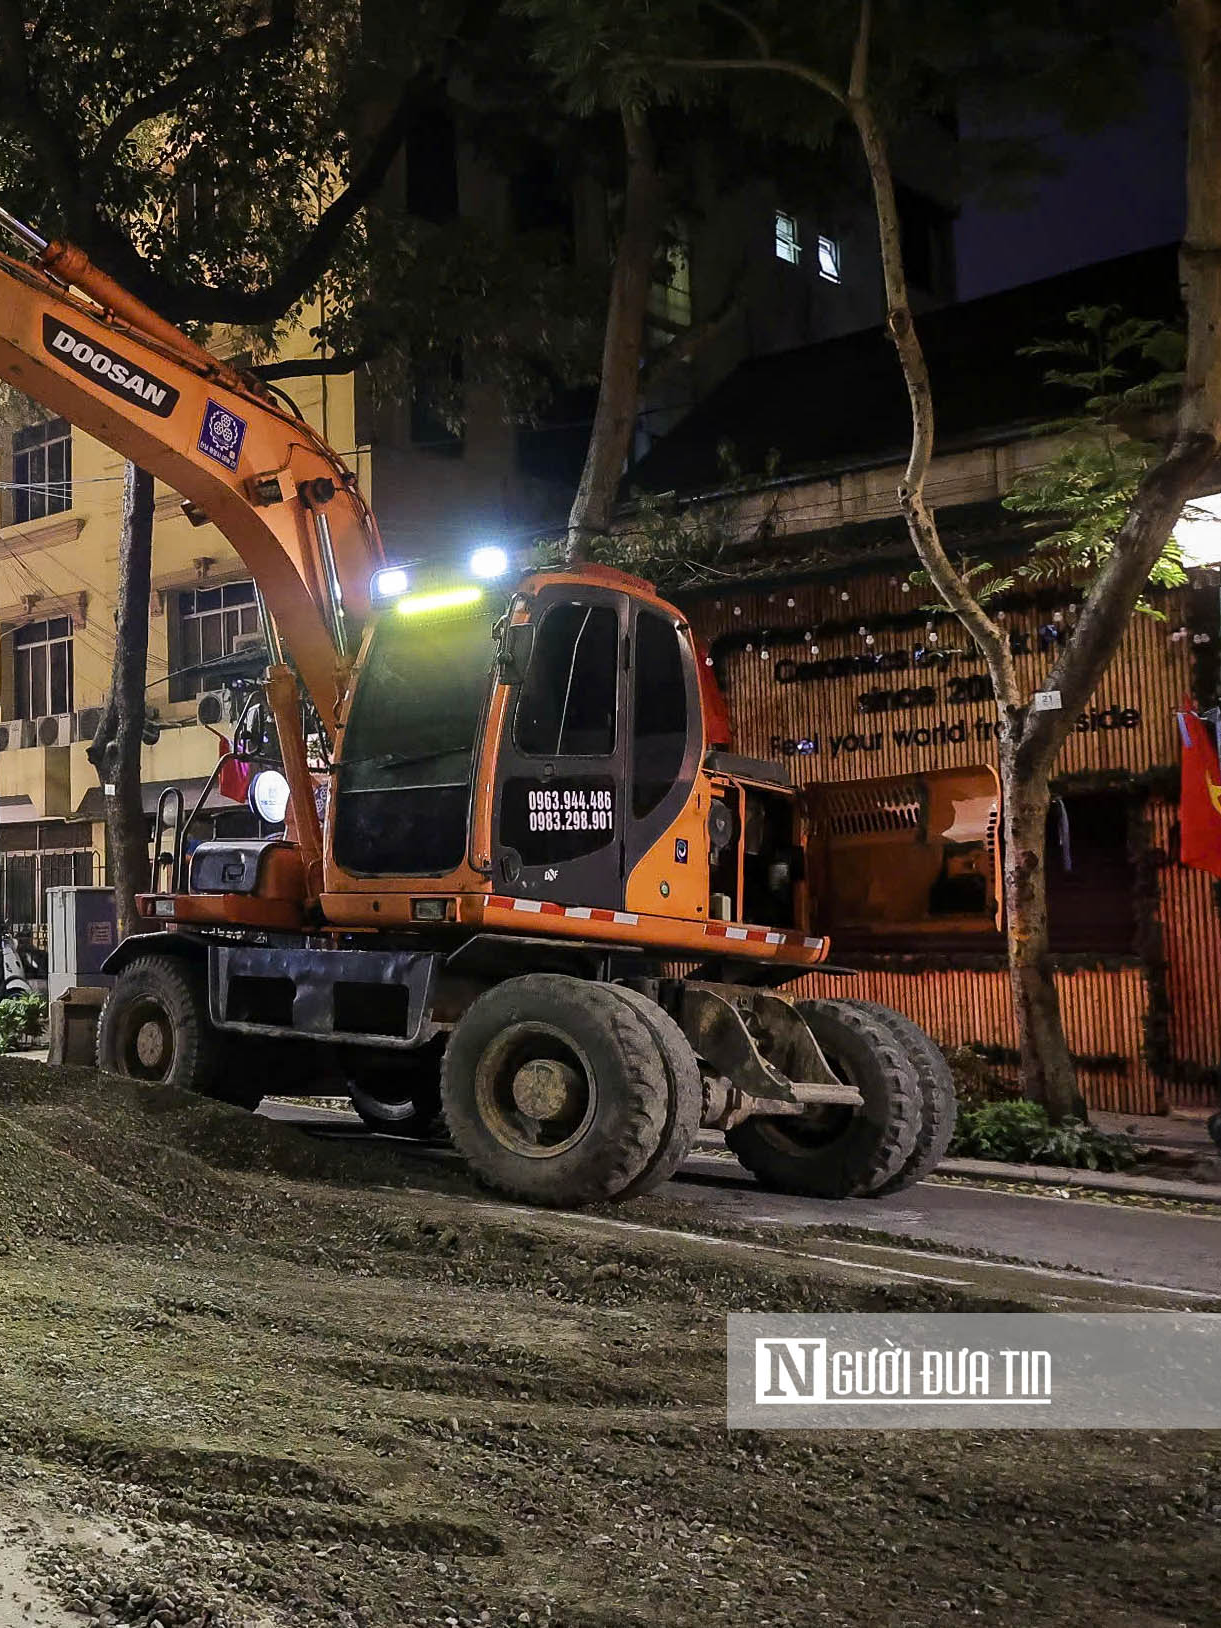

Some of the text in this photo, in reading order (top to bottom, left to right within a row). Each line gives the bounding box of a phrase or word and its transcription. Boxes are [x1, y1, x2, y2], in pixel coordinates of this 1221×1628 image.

[52, 330, 167, 406] DOOSAN
[830, 732, 882, 757] your
[894, 718, 966, 748] world
[1077, 704, 1141, 732] side
[528, 790, 612, 810] 0963.944.486
[529, 810, 613, 831] 0983.298.901
